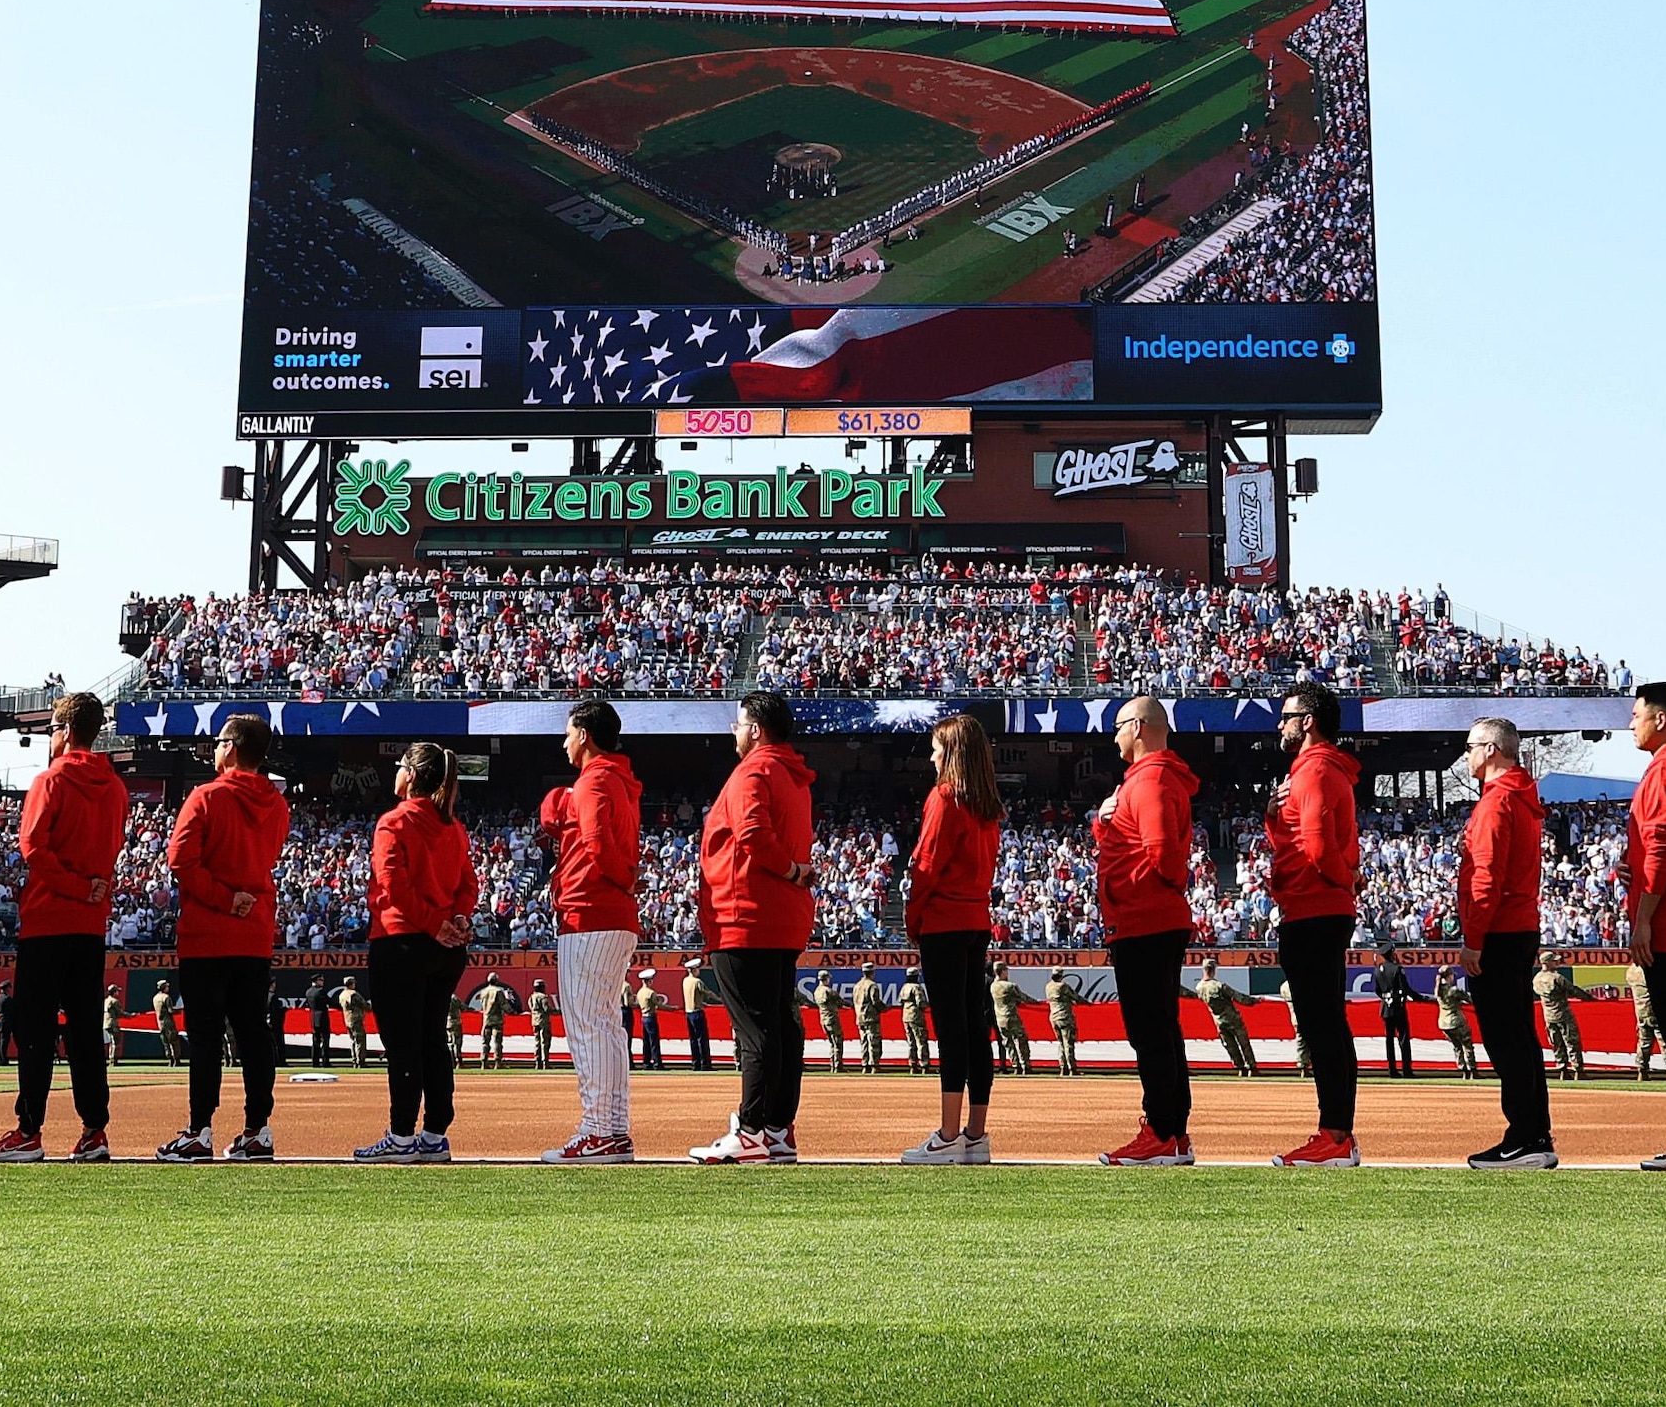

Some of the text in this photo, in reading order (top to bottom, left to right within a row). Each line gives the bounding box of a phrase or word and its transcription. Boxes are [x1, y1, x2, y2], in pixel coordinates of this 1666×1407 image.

[986, 196, 1076, 243] IBX
[275, 327, 357, 349] Driving
[1124, 334, 1319, 364] Independence
[273, 351, 362, 368] smarter
[272, 372, 390, 391] outcomes.
[241, 416, 315, 435] GALLANTLY
[837, 412, 921, 434] $61,380
[1054, 439, 1157, 497] GHOST
[425, 464, 947, 522] Citizens Bank Park
[1239, 493, 1263, 552] GHOST
[650, 527, 891, 545] GHOST ENERGY DECK
[113, 955, 179, 969] ASPLU
[271, 953, 369, 968] SPLUNDH
[819, 952, 921, 967] ASPLUND
[985, 952, 1079, 967] PLUNDH
[1391, 950, 1460, 966] ASPLU
[1560, 951, 1632, 966] PLUND
